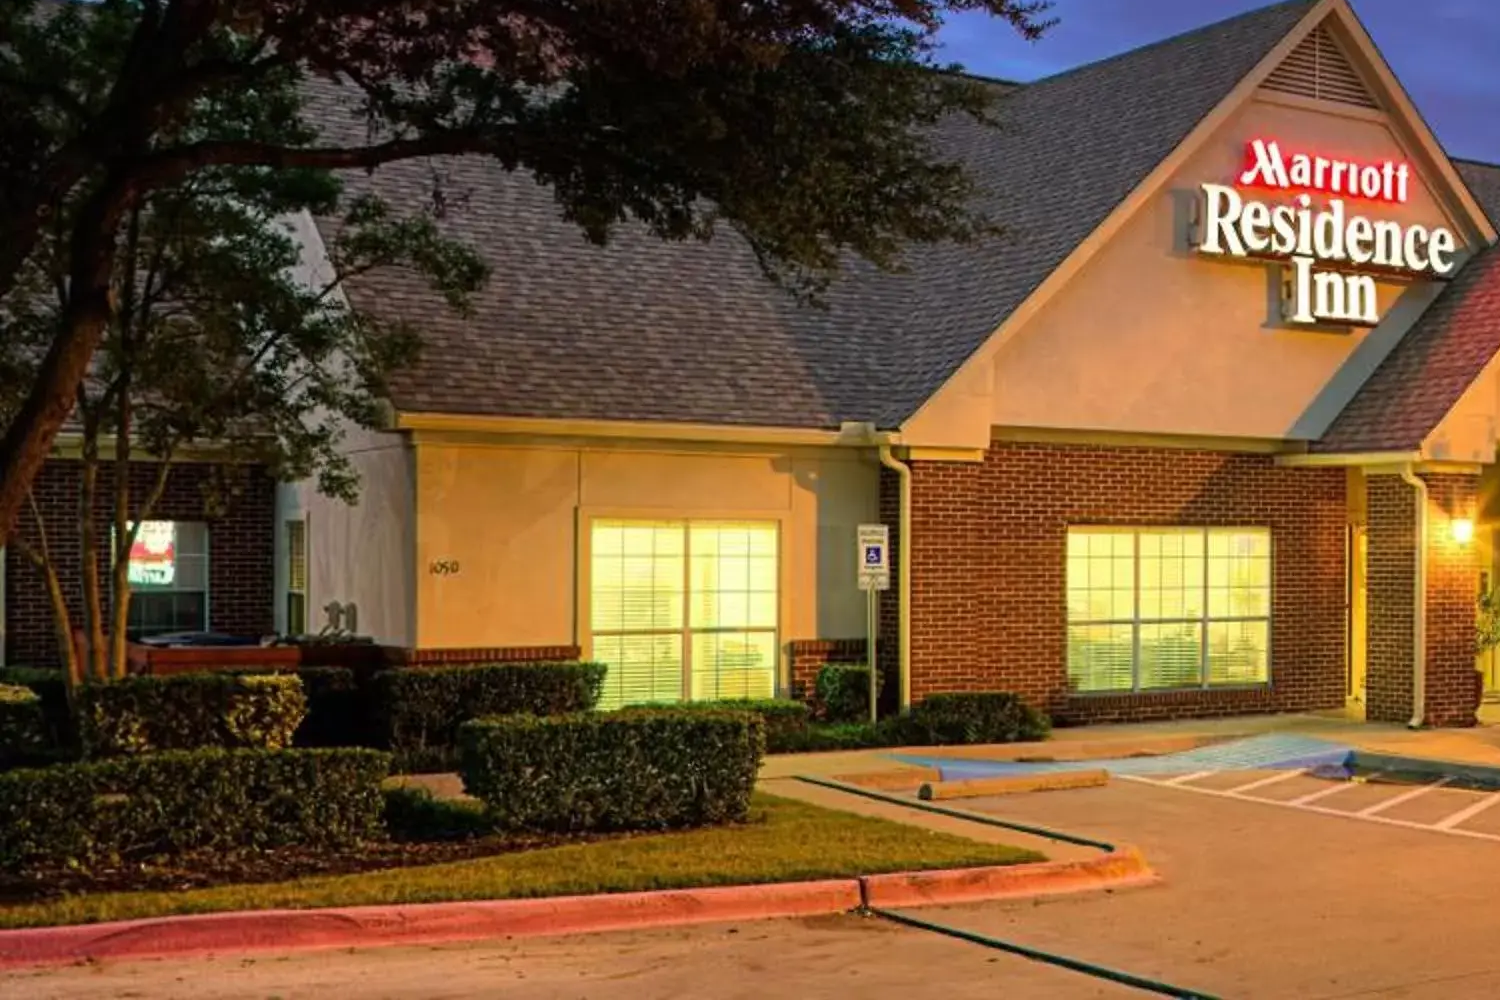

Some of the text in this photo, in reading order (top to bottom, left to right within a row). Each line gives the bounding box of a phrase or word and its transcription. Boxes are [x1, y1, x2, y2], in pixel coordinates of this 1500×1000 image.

[1241, 139, 1408, 202] Marriott
[1201, 183, 1455, 273] Residence
[1292, 256, 1379, 324] Inn
